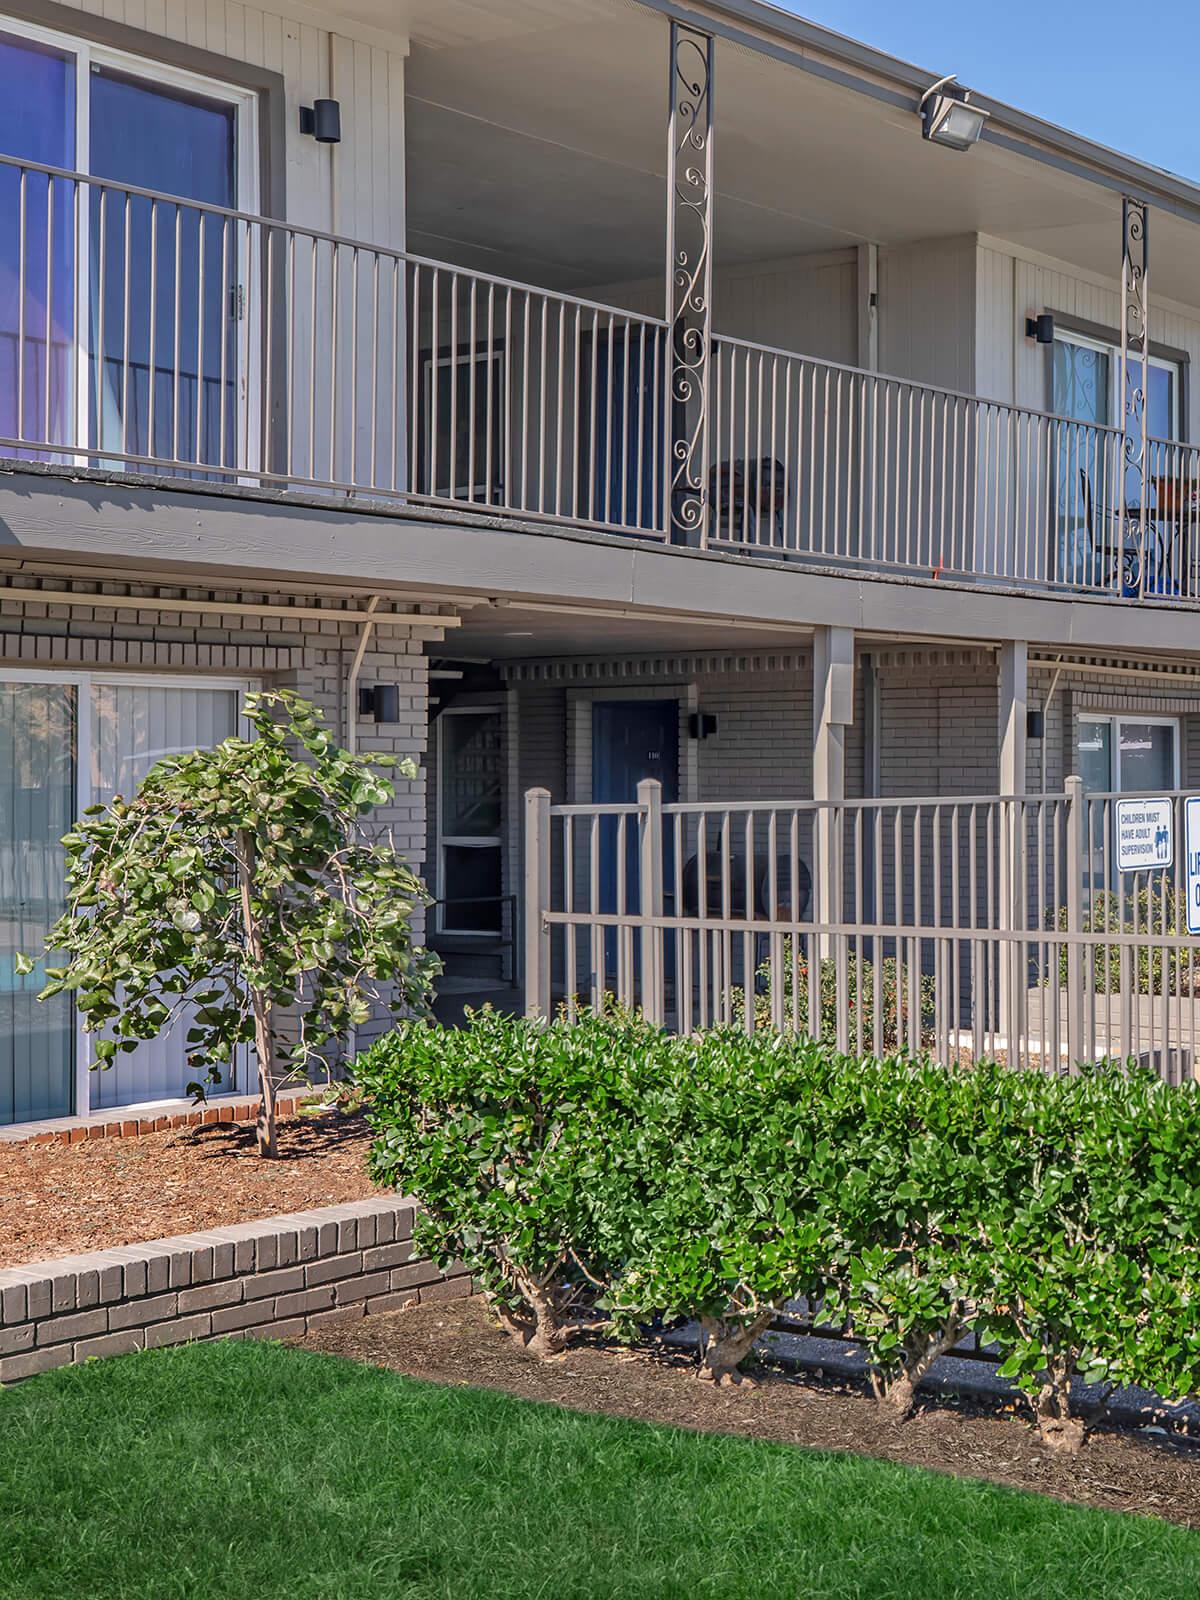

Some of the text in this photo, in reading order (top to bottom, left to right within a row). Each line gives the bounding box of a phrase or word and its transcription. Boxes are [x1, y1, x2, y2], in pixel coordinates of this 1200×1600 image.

[1121, 812, 1160, 824] CHILDREN MUST
[1121, 828, 1151, 840] HAVE ADULT
[1121, 843, 1153, 856] SUPERVISION
